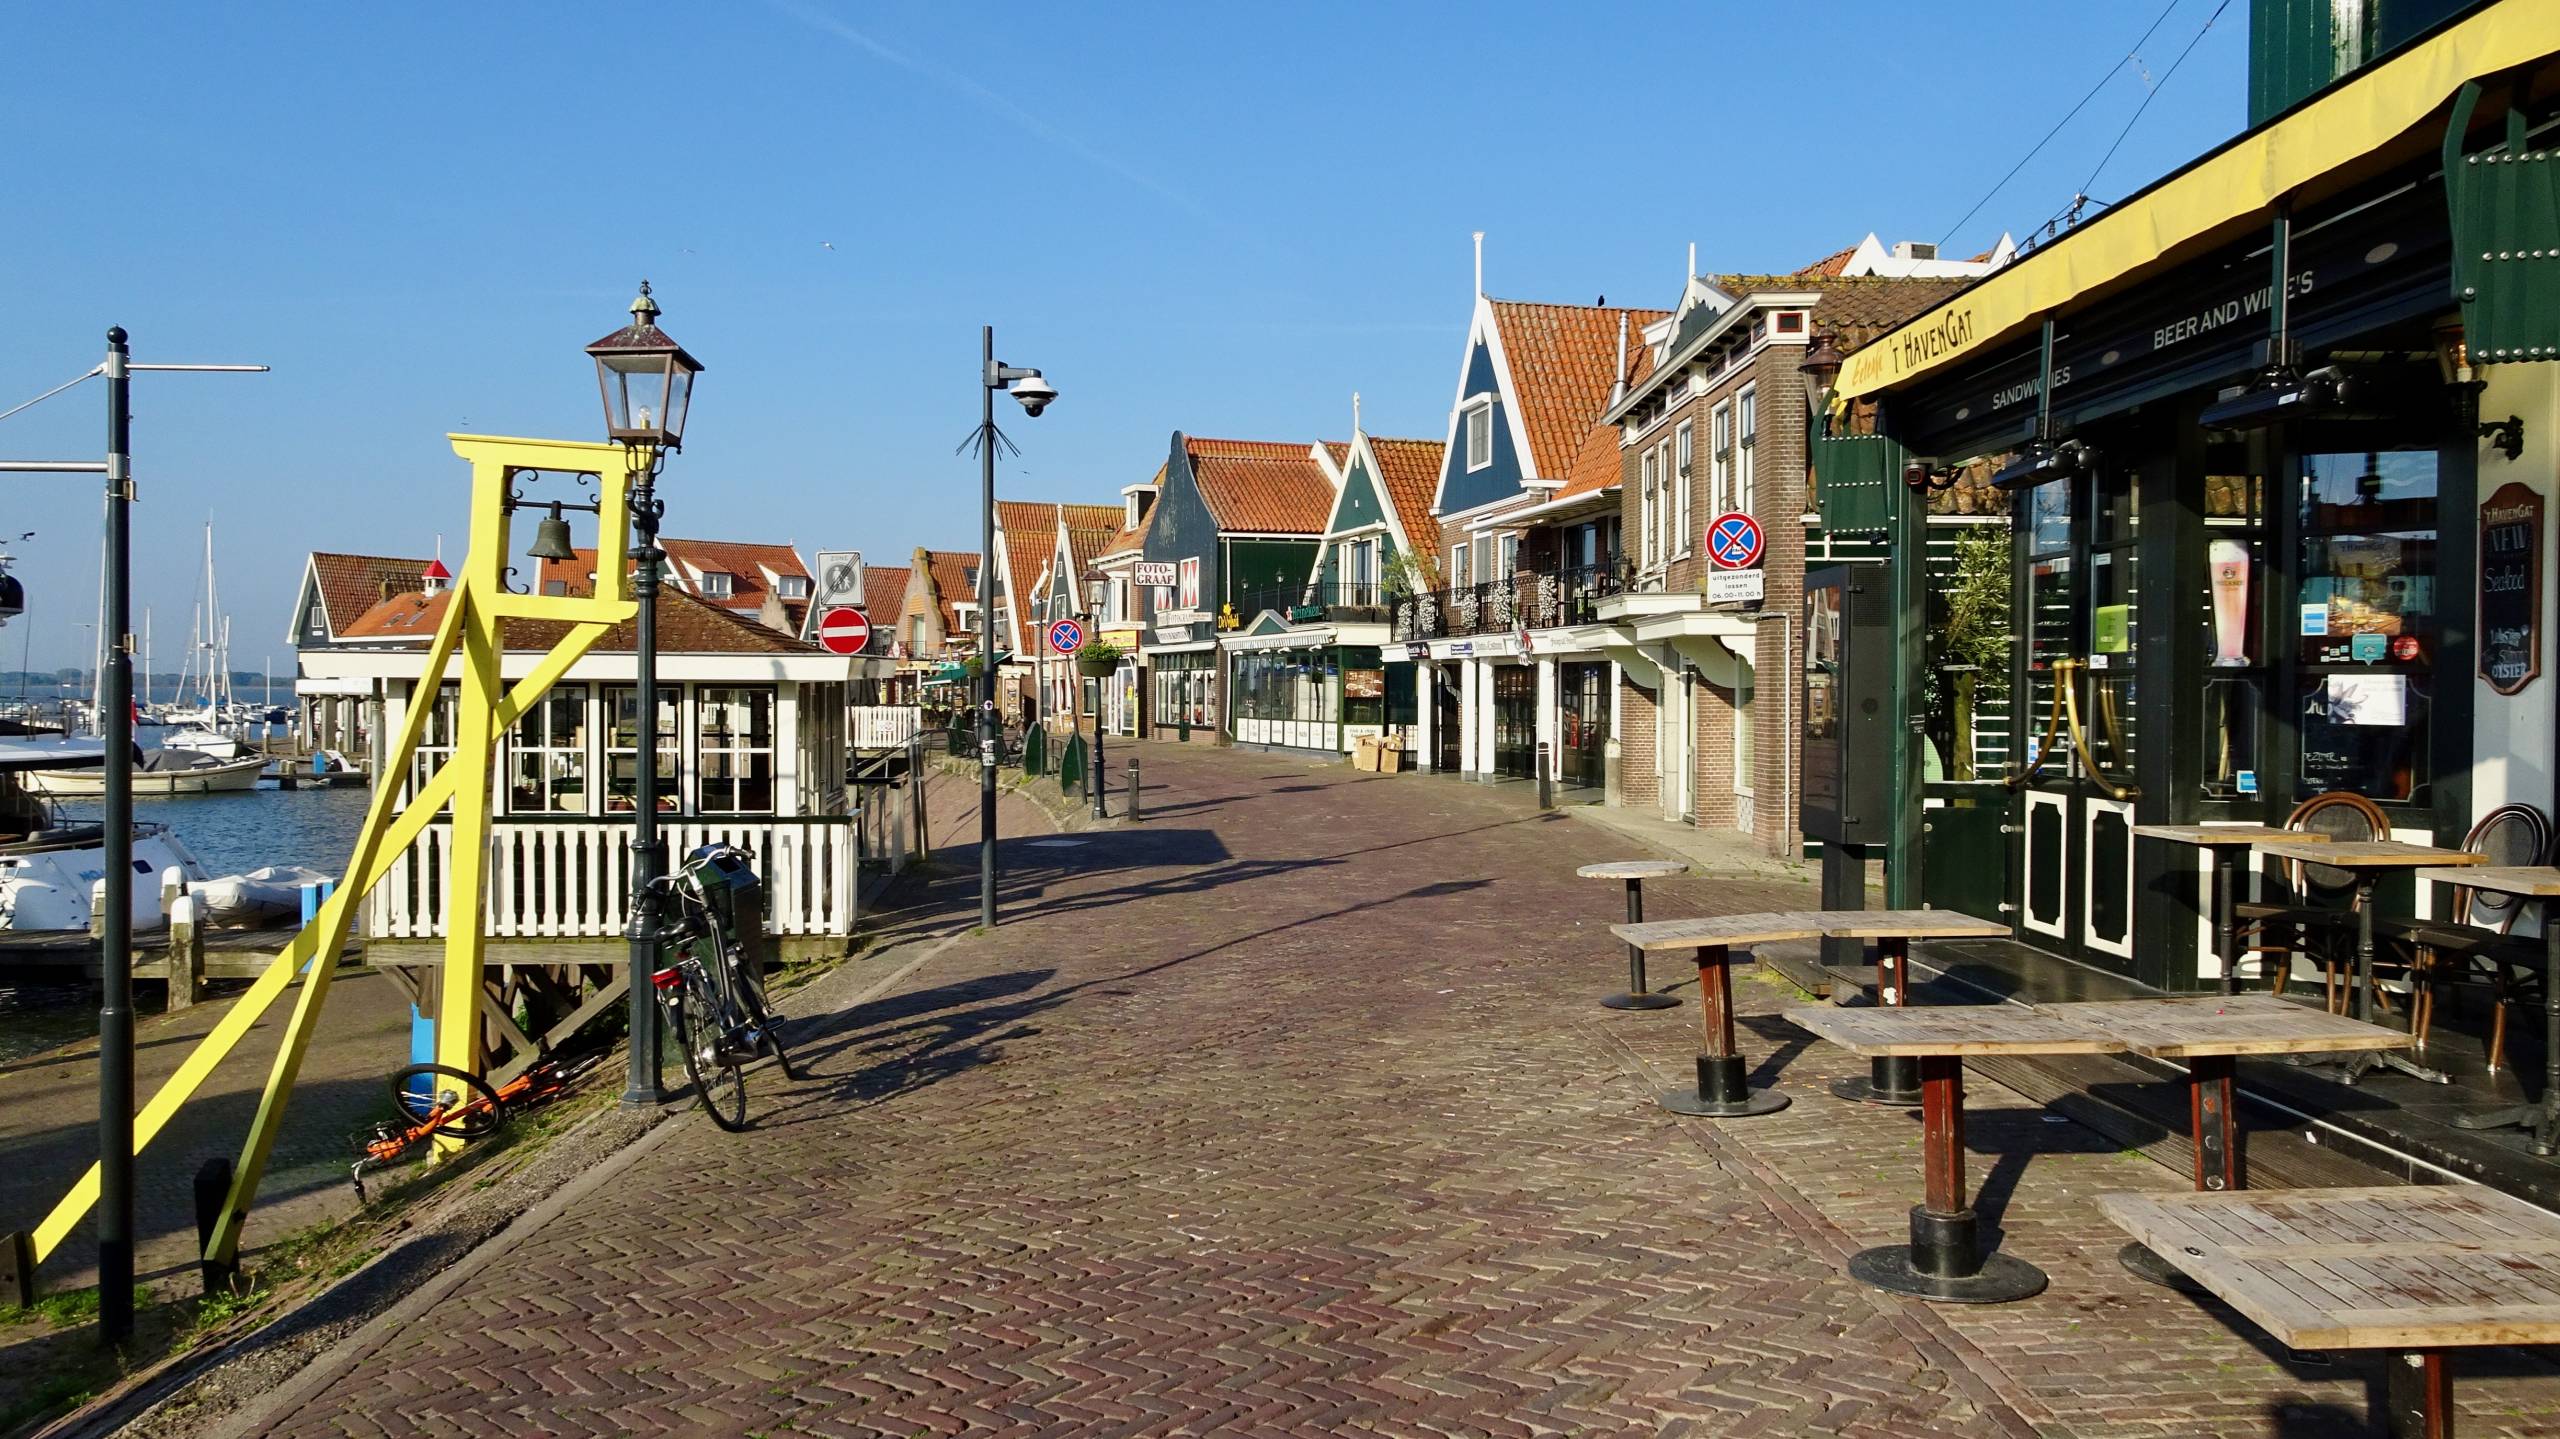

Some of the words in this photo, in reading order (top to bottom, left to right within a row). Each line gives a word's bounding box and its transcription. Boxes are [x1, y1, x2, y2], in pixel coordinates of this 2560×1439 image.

[2153, 316, 2198, 350] BEER
[2200, 300, 2239, 333] AND
[1137, 563, 1172, 573] FOTO-
[1136, 575, 1174, 585] GRAAF
[1712, 573, 1760, 581] uitgezonderd
[2491, 662, 2527, 678] OYSTER
